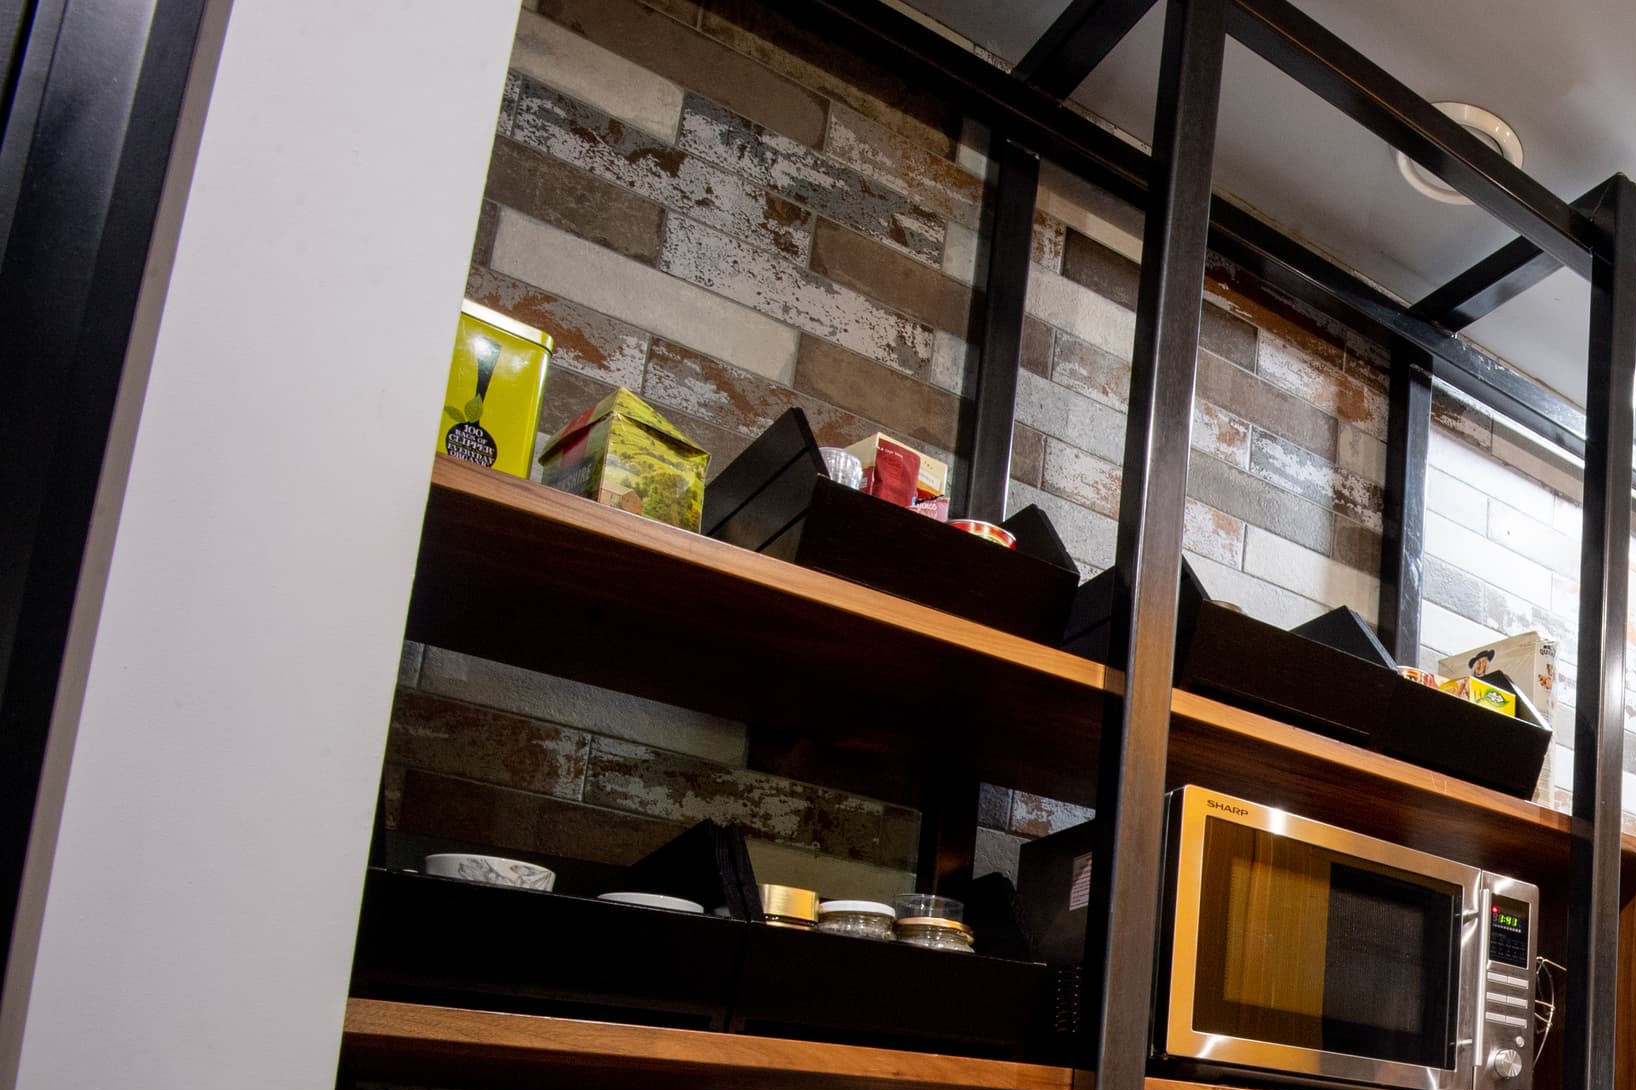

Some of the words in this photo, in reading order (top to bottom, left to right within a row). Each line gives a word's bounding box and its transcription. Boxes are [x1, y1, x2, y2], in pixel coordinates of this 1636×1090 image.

[464, 424, 484, 437] 100
[448, 433, 495, 455] CLIPPER
[1207, 799, 1249, 816] SHARP
